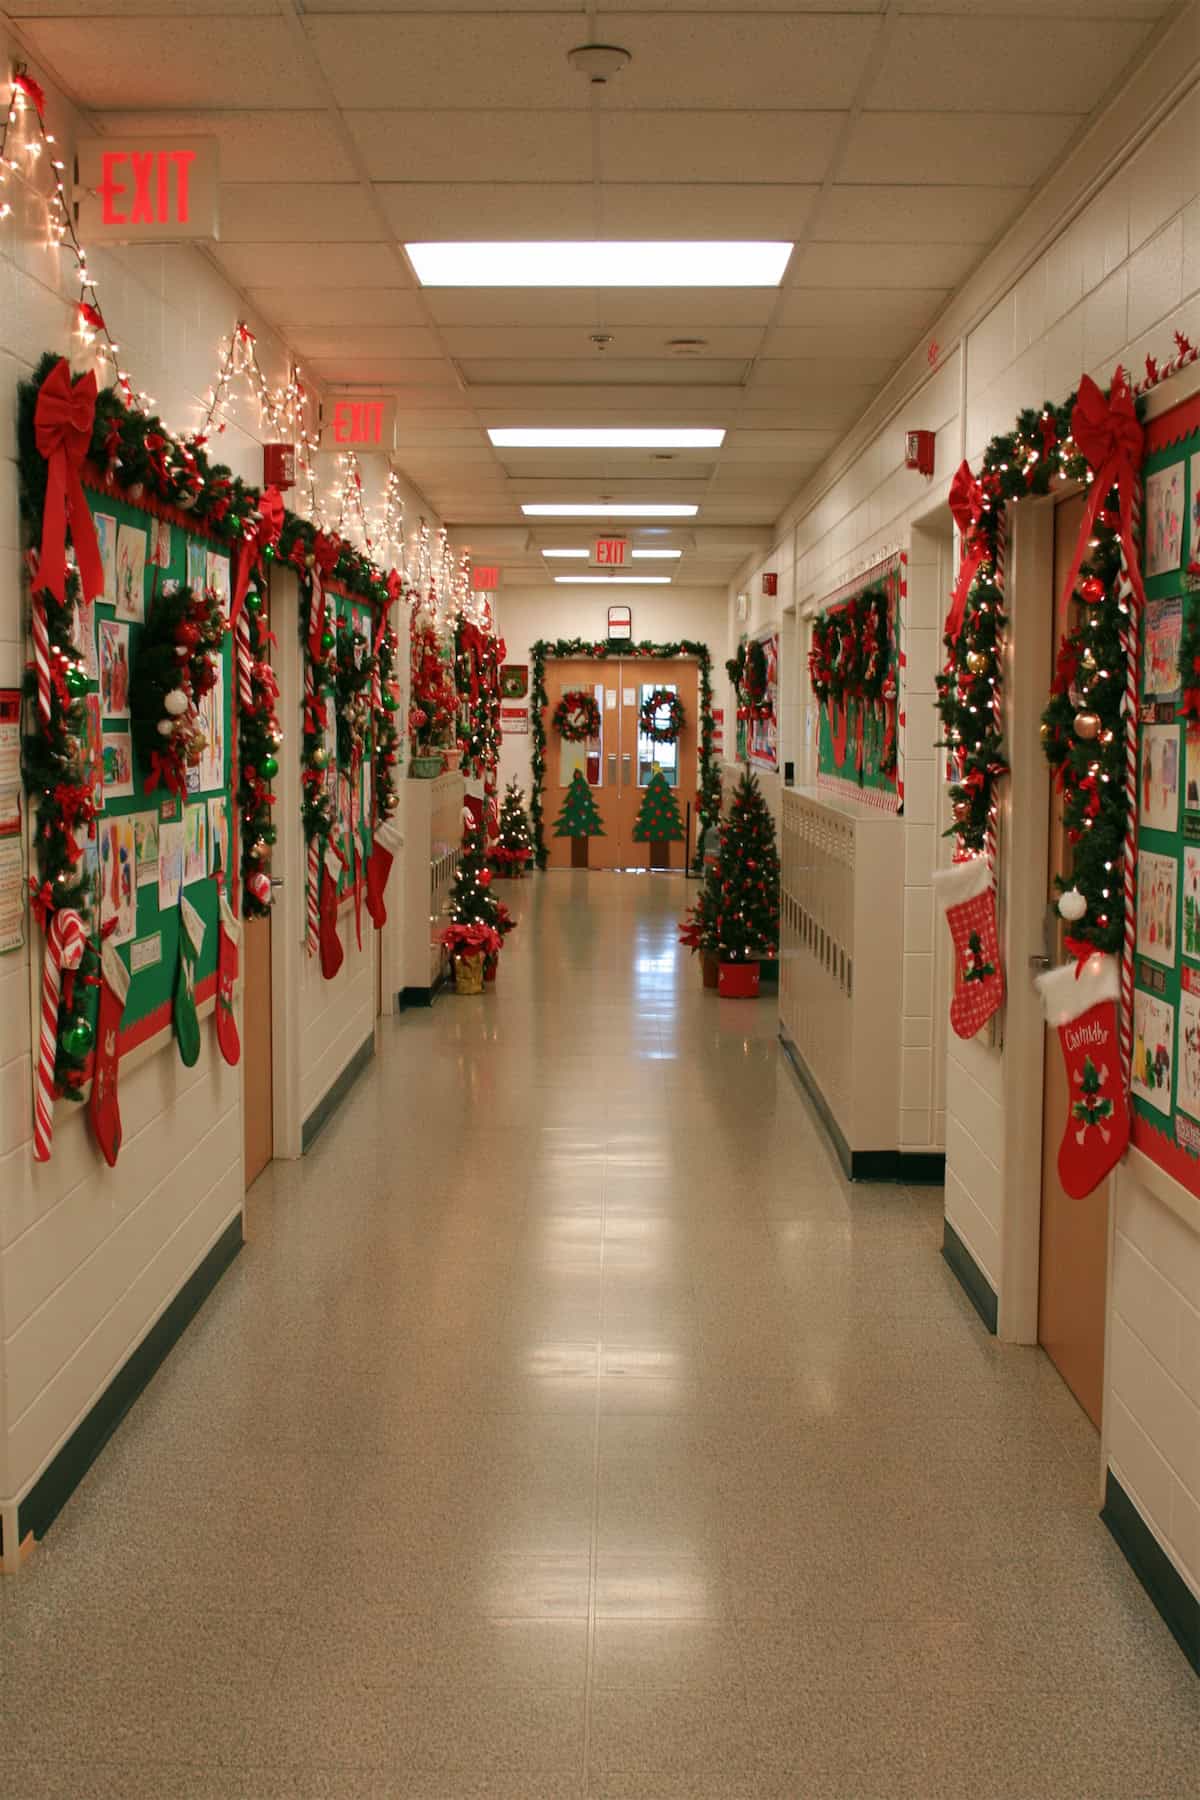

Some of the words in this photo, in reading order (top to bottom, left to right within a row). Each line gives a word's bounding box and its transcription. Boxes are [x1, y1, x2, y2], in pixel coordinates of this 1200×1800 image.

[97, 150, 196, 224] EXIT
[333, 402, 384, 442] EXIT
[596, 540, 627, 564] EXIT
